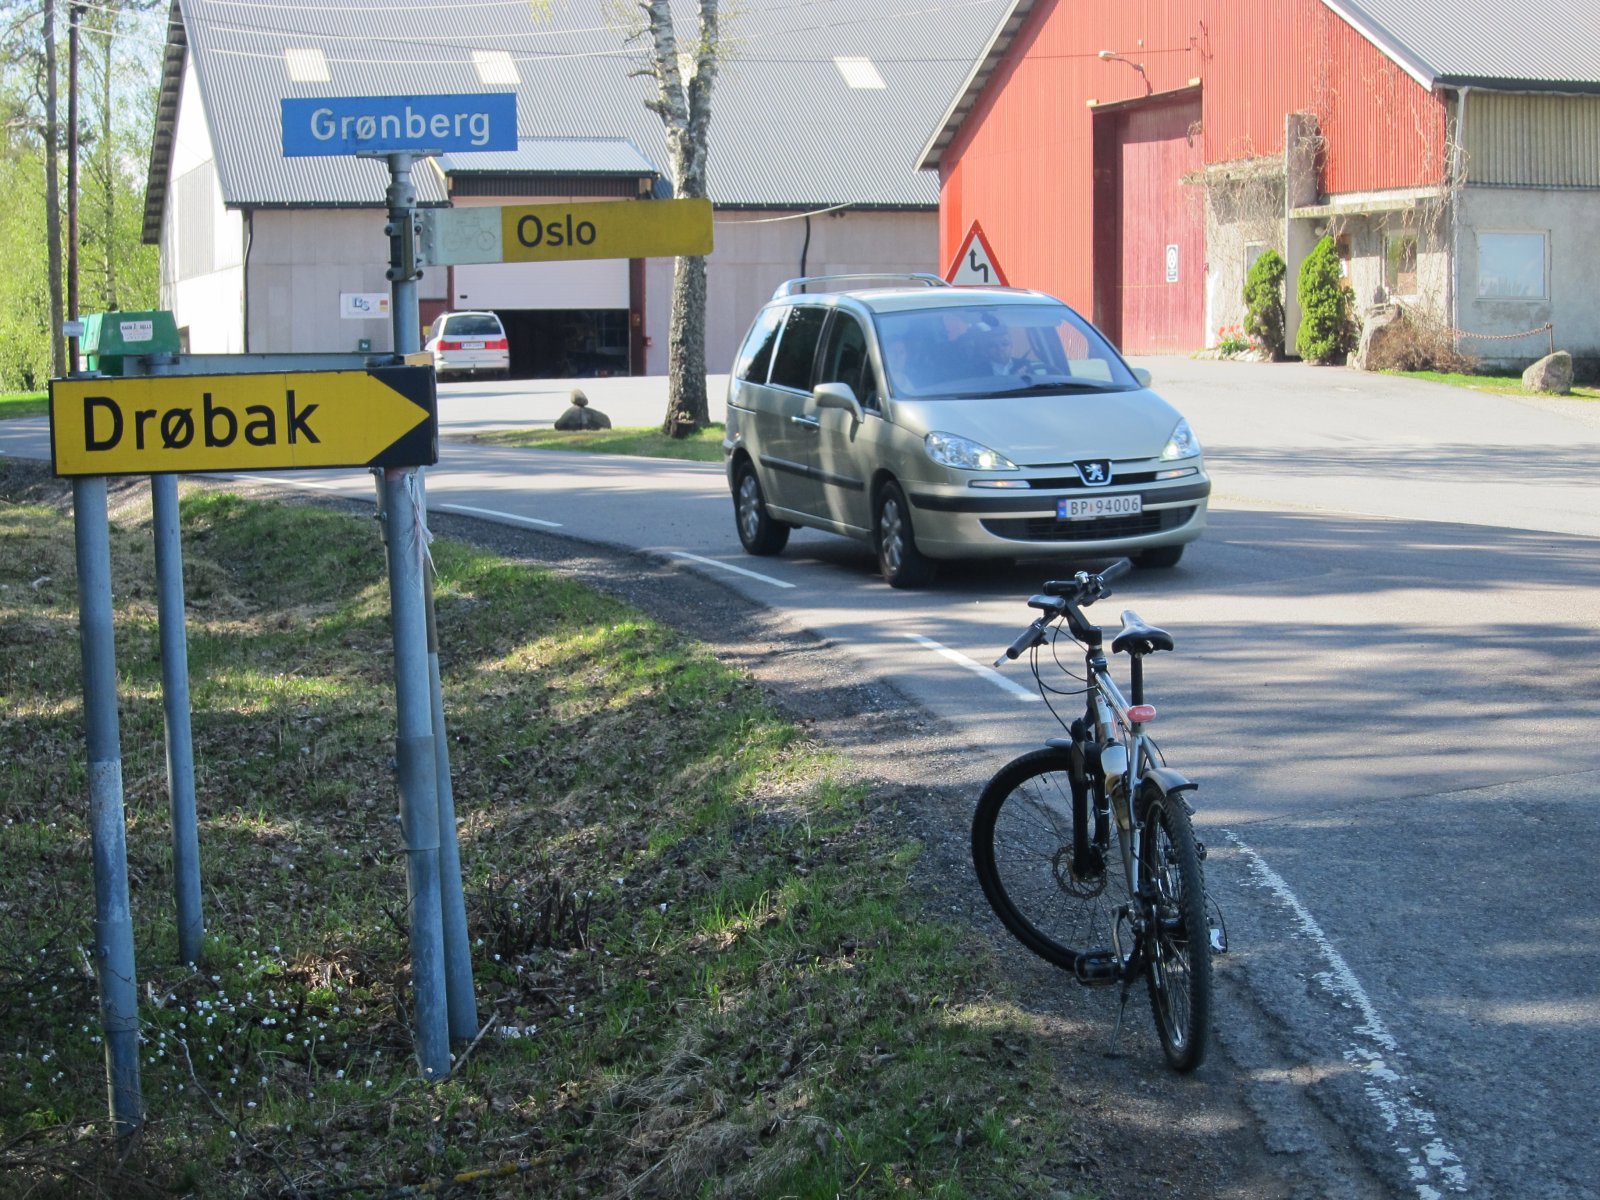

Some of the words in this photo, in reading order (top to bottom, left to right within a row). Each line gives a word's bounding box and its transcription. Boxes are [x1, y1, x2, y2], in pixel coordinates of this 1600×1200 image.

[310, 106, 490, 146] Grønberg
[517, 214, 596, 247] Oslo
[83, 390, 321, 452] Drøbak
[1095, 497, 1139, 514] 94006
